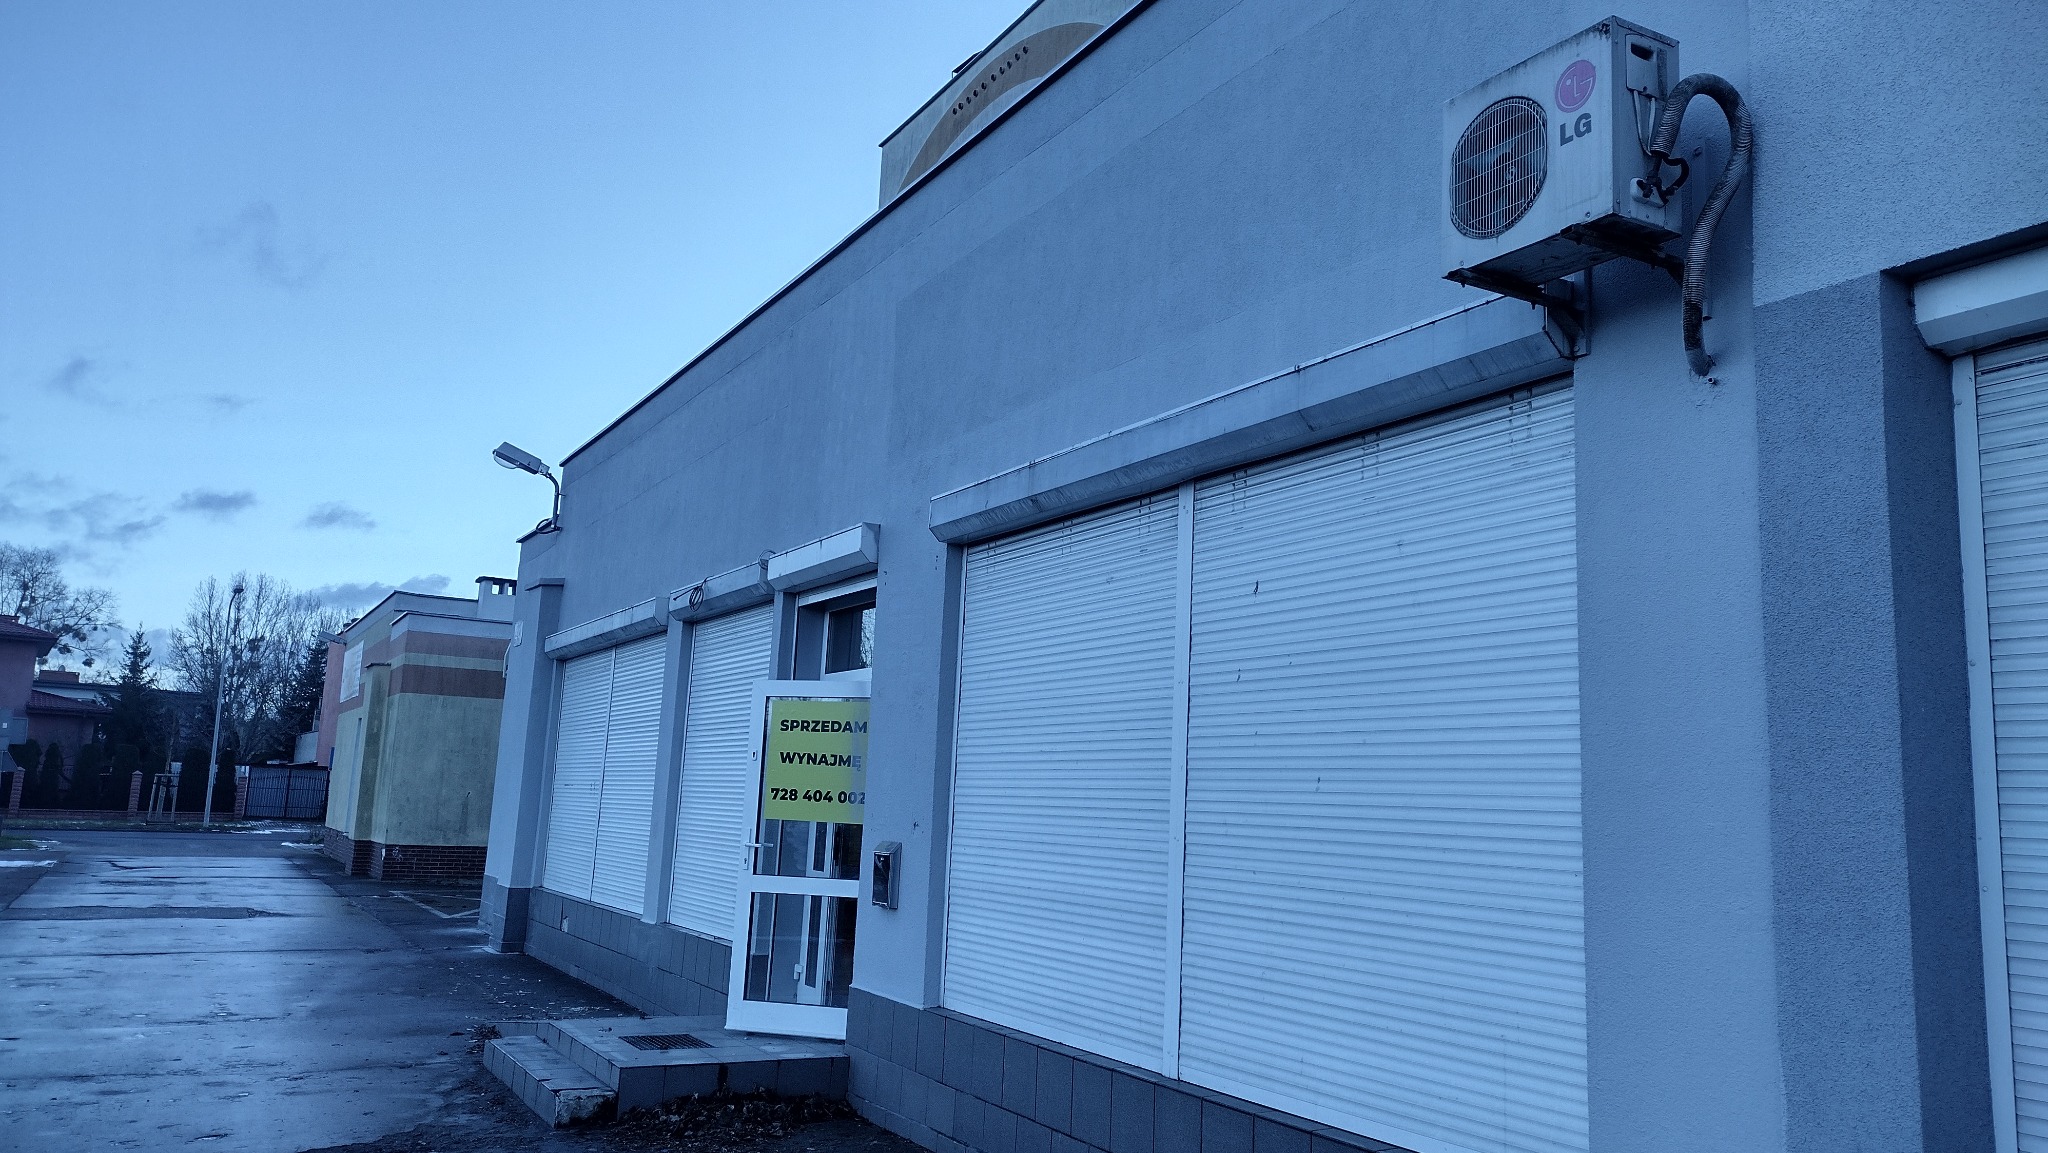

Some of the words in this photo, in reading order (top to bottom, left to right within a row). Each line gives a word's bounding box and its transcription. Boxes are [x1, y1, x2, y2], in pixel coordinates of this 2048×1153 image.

[1560, 113, 1592, 146] LG
[780, 719, 868, 733] SPRZEDAM
[780, 752, 861, 771] WYNAJMĘ
[770, 788, 798, 801] 728
[803, 789, 833, 802] 404
[838, 791, 865, 804] 002
